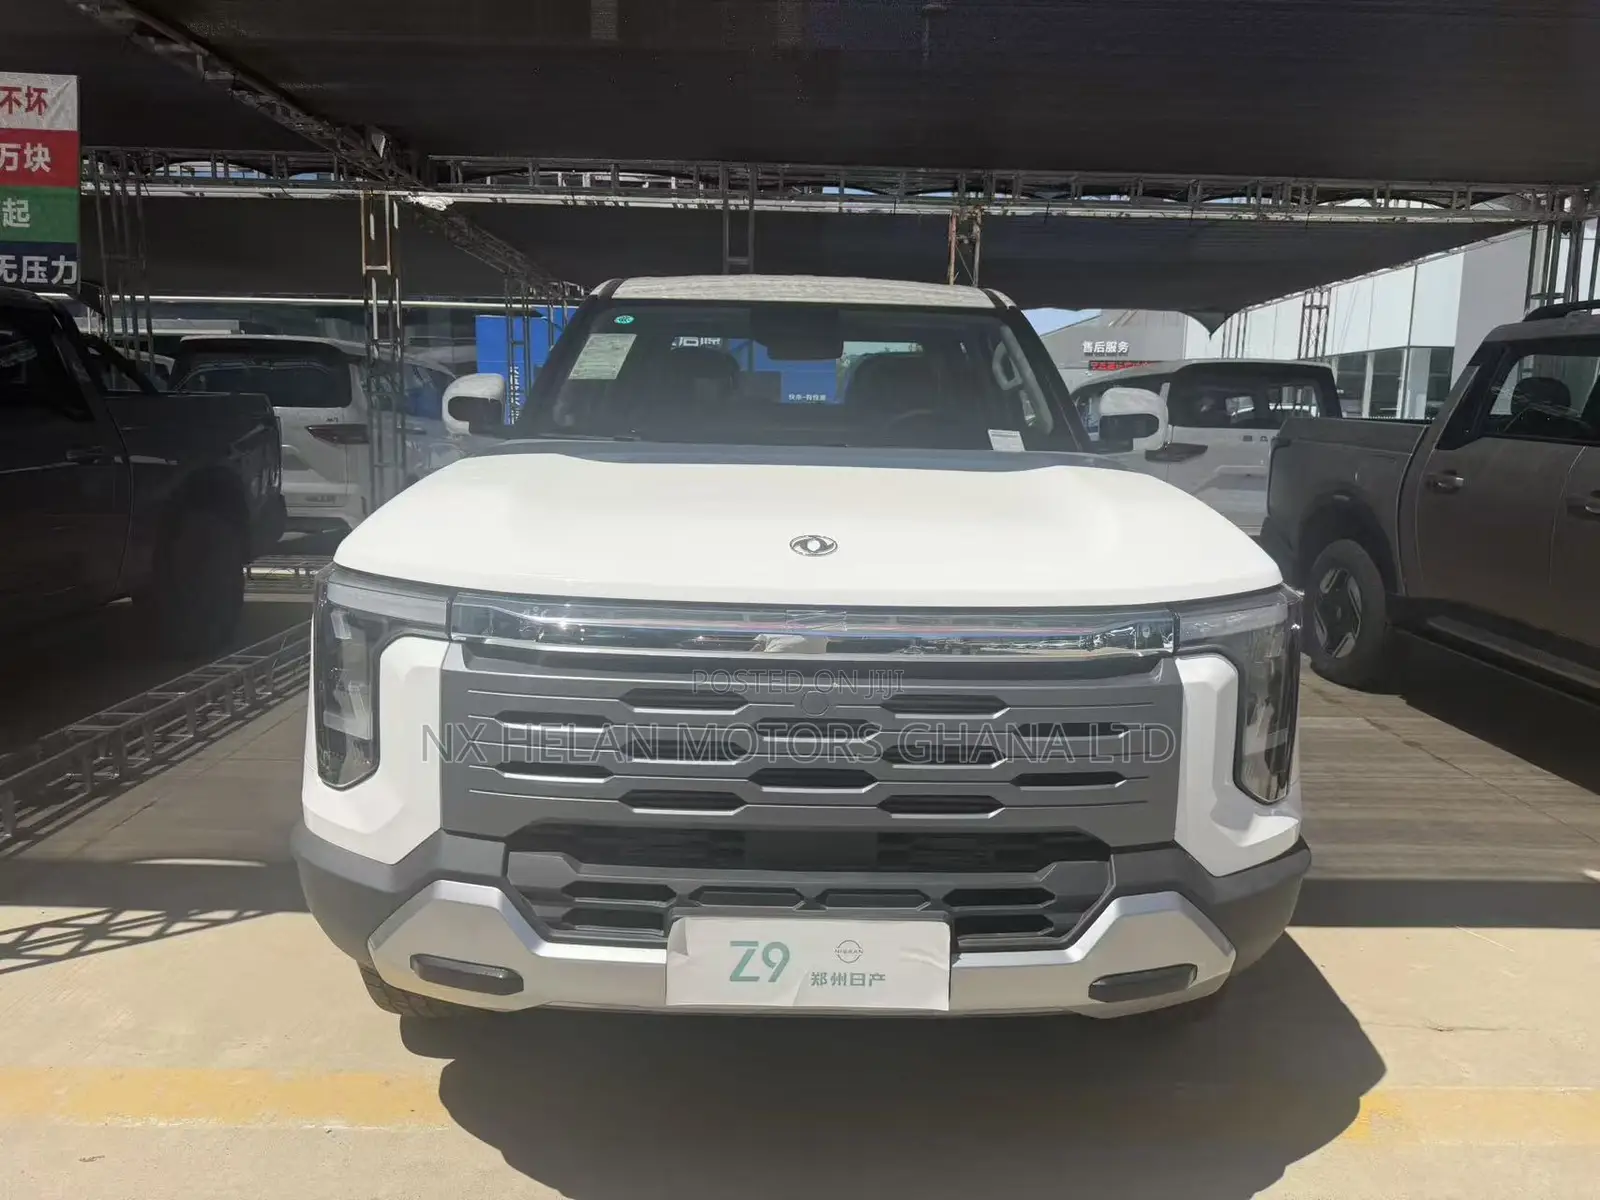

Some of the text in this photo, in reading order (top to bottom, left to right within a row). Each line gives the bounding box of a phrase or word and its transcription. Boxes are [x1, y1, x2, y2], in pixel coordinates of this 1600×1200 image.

[1082, 340, 1129, 353] 售后服务
[729, 940, 790, 982] Z9
[811, 971, 886, 987] 郑州日产
